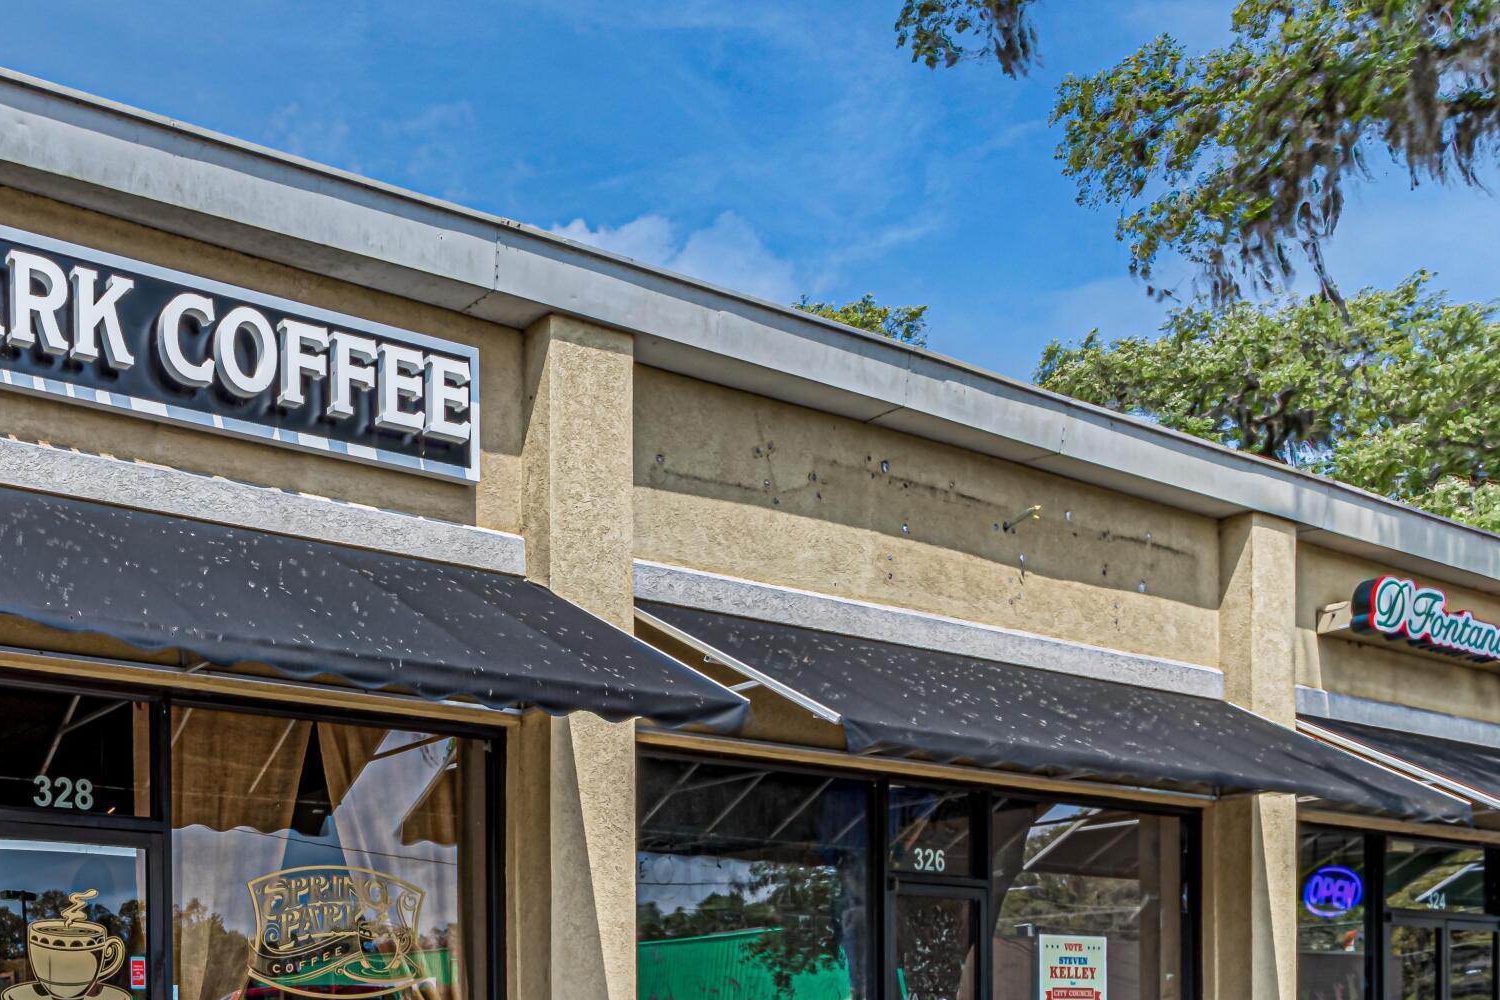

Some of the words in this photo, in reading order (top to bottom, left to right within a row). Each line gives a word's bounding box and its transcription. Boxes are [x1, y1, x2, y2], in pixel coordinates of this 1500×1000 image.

[157, 293, 472, 444] COFFEE
[33, 775, 94, 810] 328
[914, 848, 945, 872] 326
[1310, 874, 1356, 909] OPEN
[1427, 892, 1446, 909] 324
[1064, 943, 1083, 951] VOTE
[272, 946, 342, 973] COFFEE
[1059, 957, 1088, 965] STEVEN
[1050, 966, 1096, 979] KELLEY
